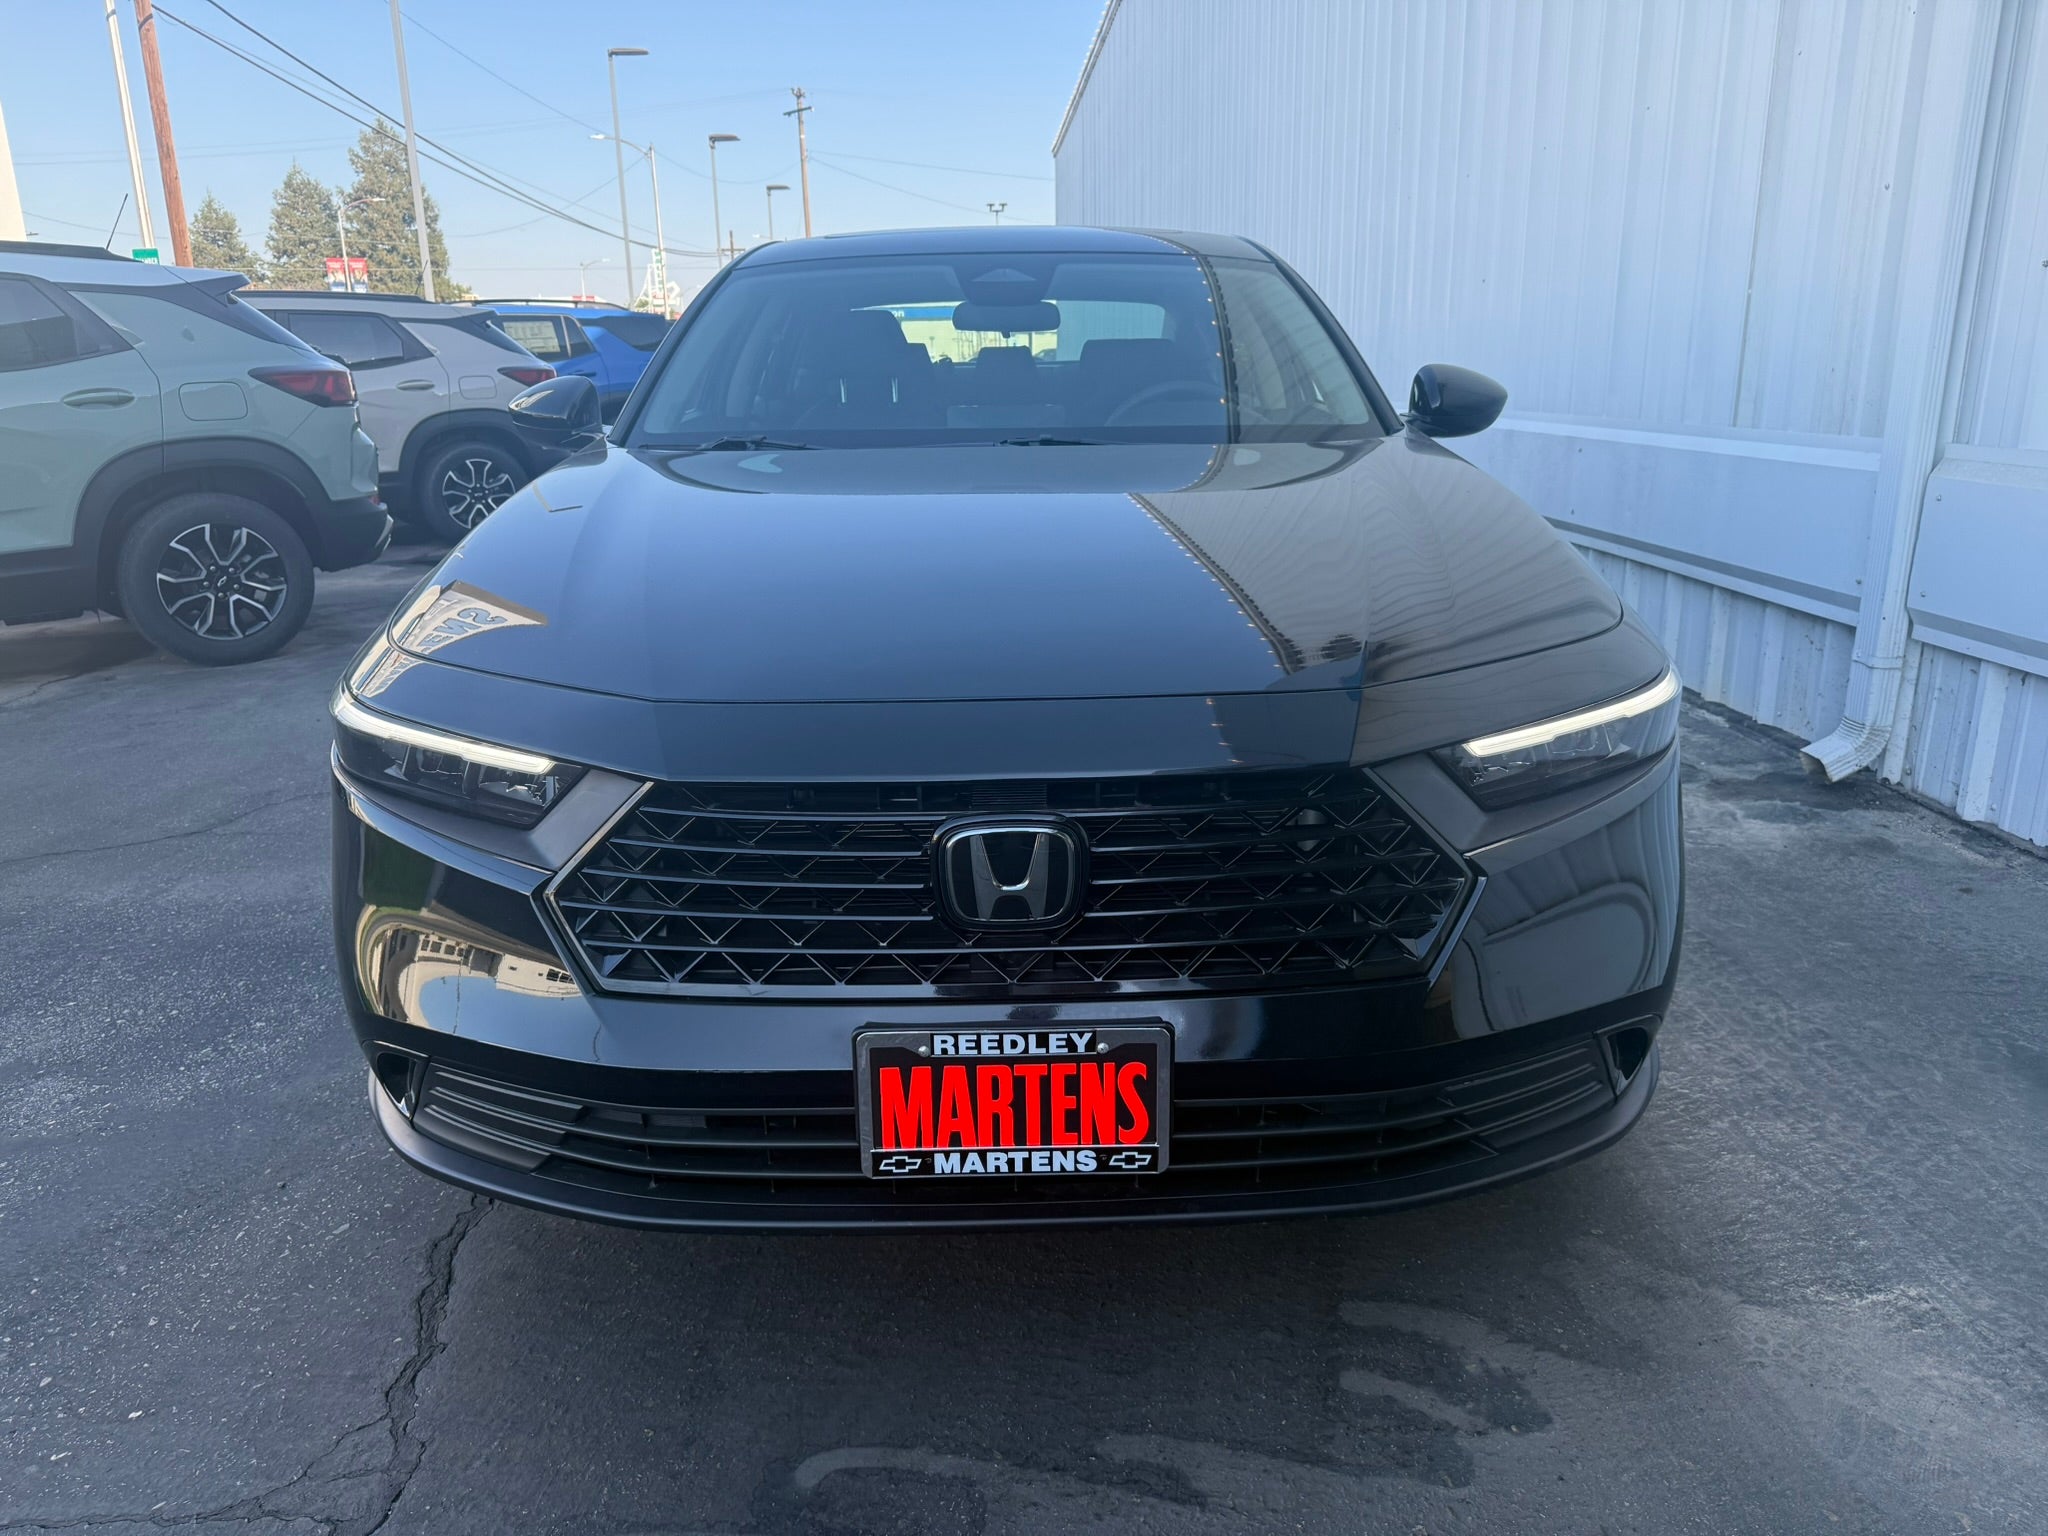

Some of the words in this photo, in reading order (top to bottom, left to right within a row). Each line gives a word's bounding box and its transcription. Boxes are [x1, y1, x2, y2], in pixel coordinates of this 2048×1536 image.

[933, 1033, 1092, 1055] REEDLEY
[879, 1062, 1149, 1150] MARTENS
[933, 1150, 1097, 1174] MARTENS
